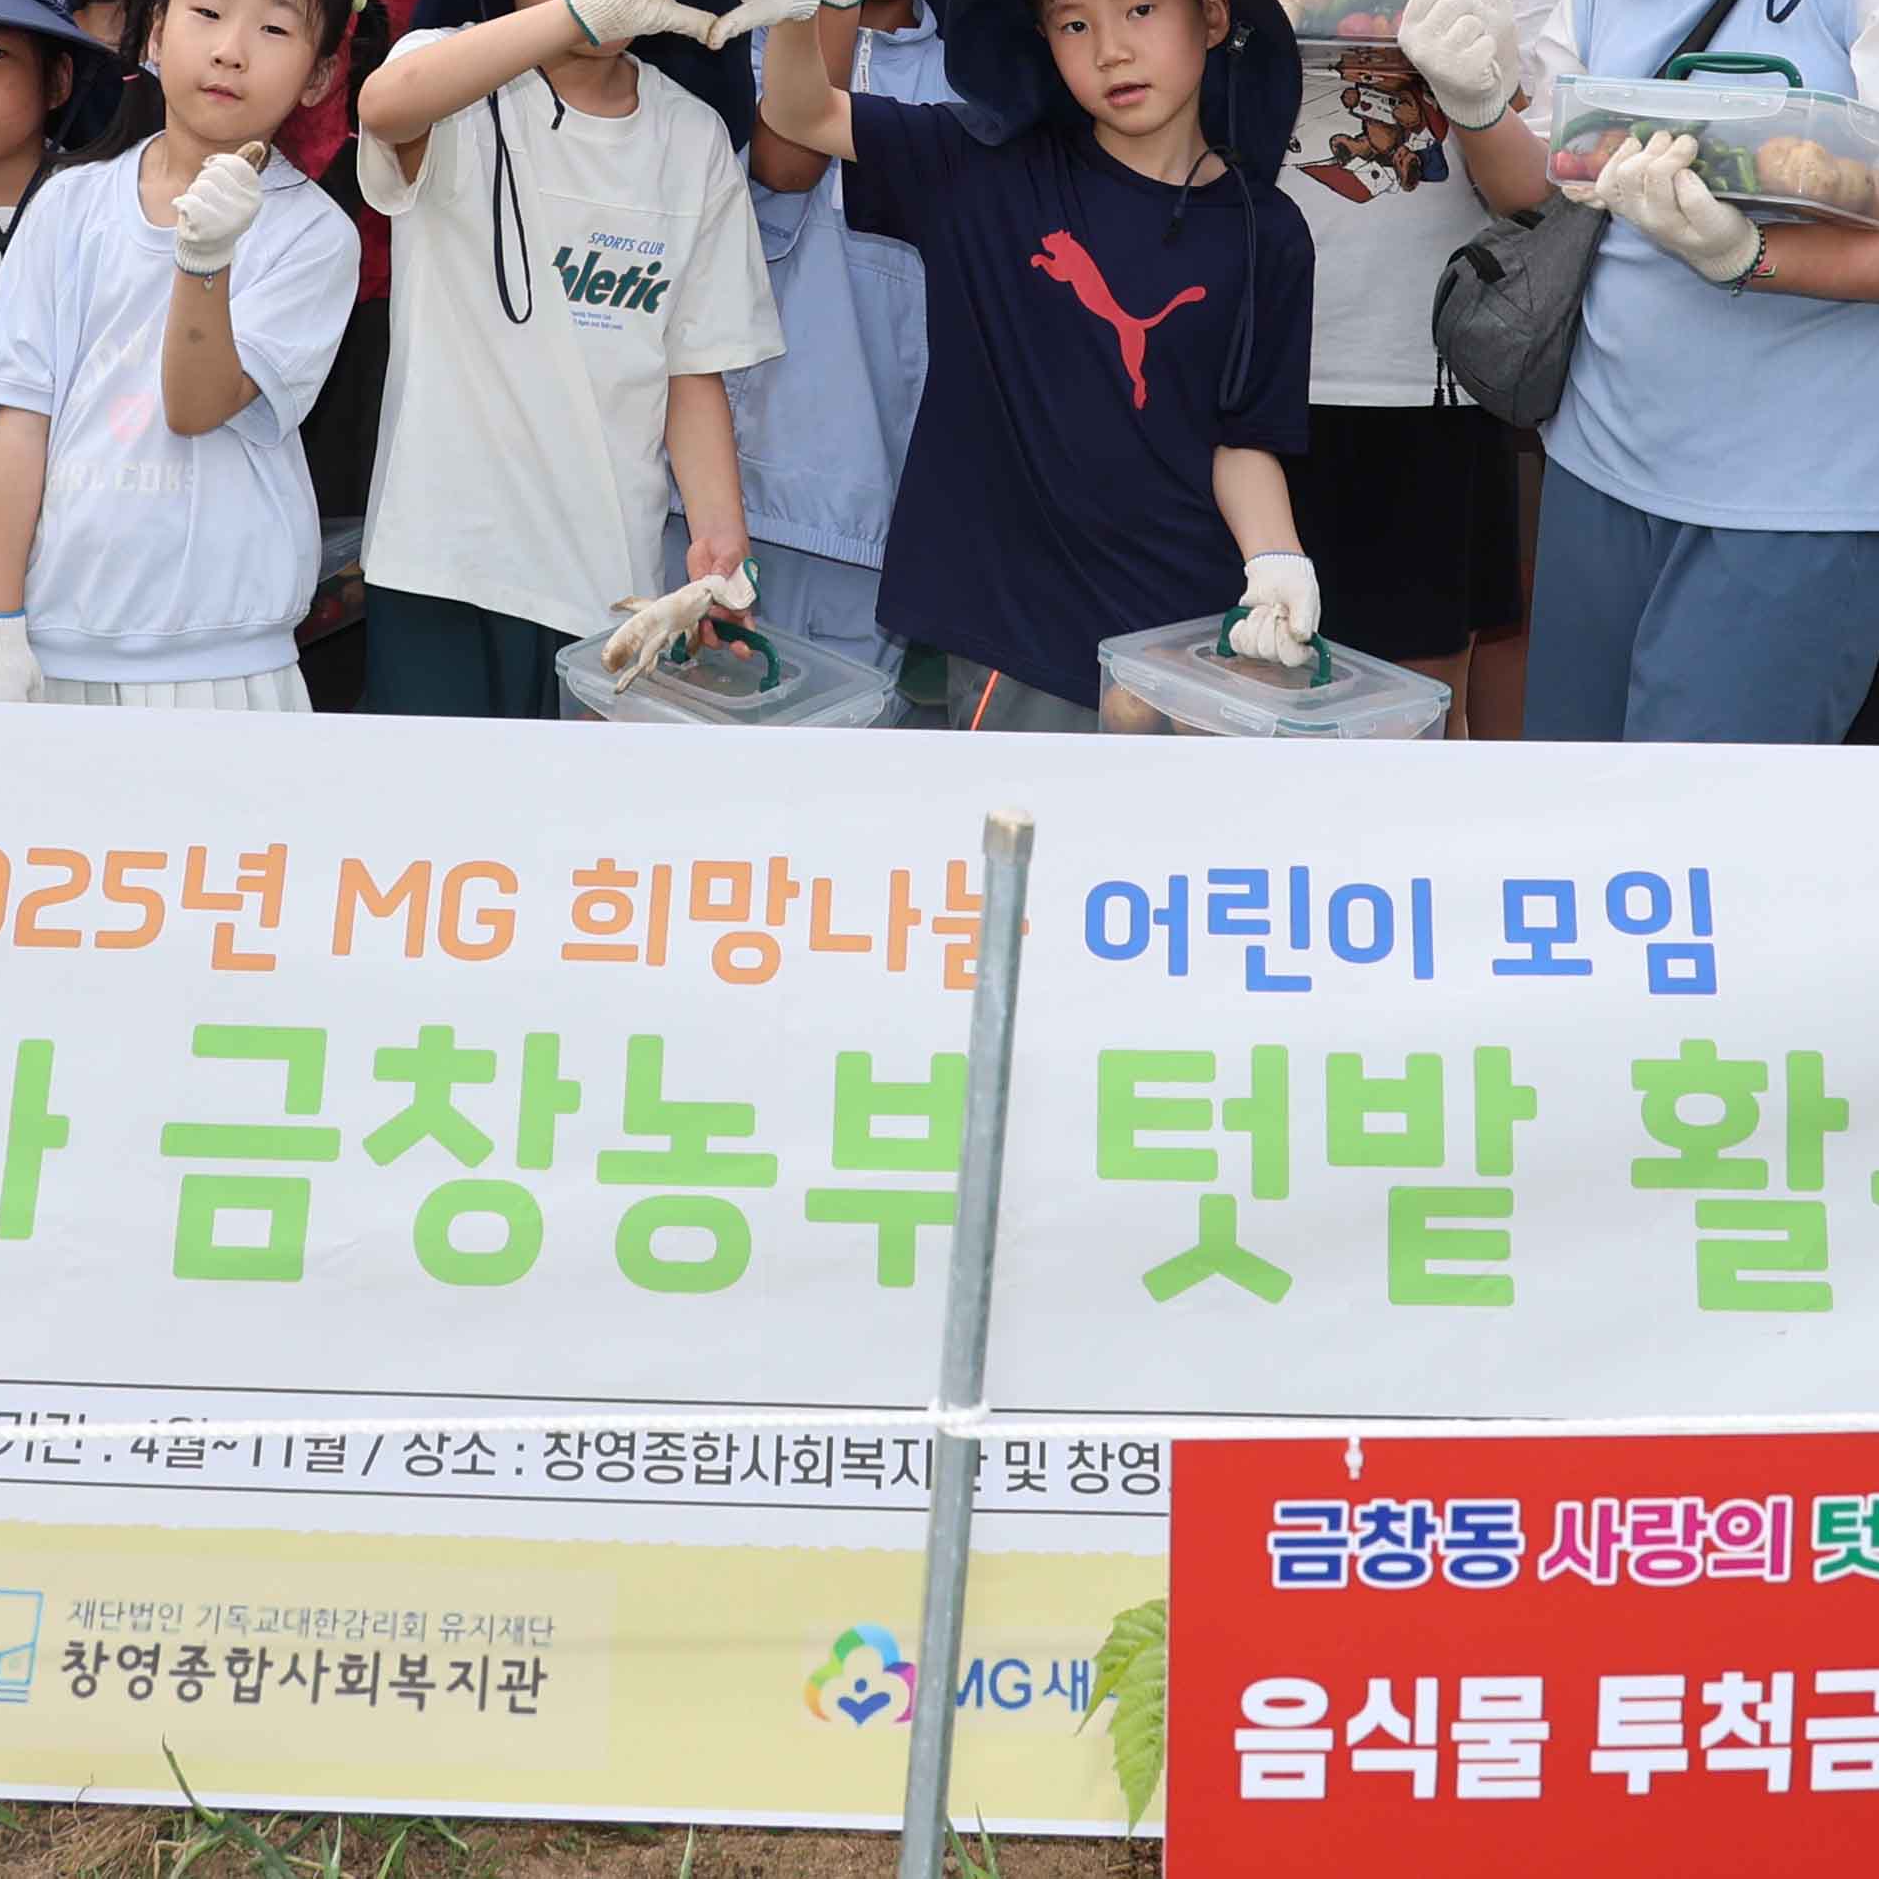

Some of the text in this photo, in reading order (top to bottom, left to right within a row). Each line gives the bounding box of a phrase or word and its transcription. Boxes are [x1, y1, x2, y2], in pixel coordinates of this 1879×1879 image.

[587, 231, 666, 256] SPORTS CLUB
[331, 857, 519, 962] MG
[1084, 865, 1435, 993] 어린이
[1492, 867, 1718, 996] 모임
[159, 1023, 971, 1295] 금창농부
[1096, 1043, 1538, 1307] 텃밭
[1004, 1439, 1049, 1493] 및
[1066, 1439, 1172, 1498] 창영
[1271, 1502, 1522, 1585] 금창동
[1539, 1496, 1791, 1583] 사랑의
[66, 1598, 558, 1650] 재단법인 기독교대한감리회 유지재단
[61, 1639, 551, 1716] 창영종합사회복지관
[1233, 1675, 1551, 1800] 음식물
